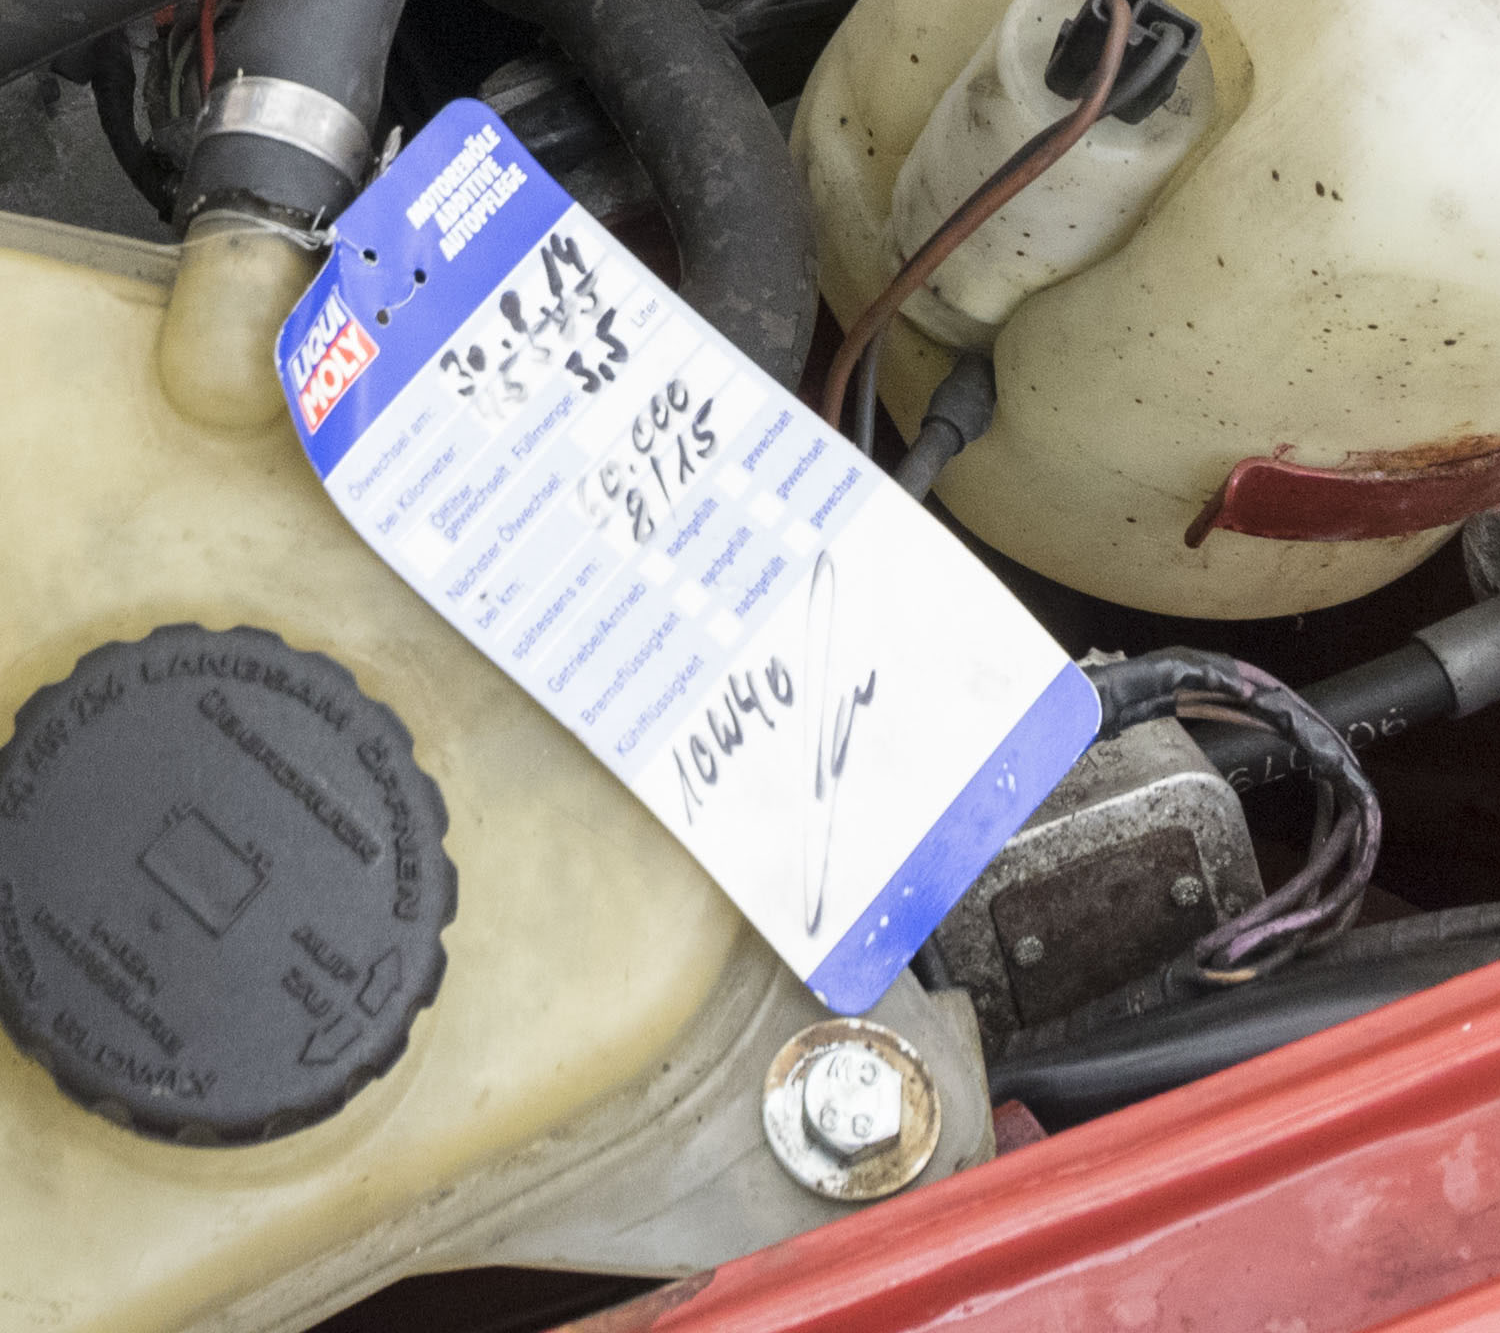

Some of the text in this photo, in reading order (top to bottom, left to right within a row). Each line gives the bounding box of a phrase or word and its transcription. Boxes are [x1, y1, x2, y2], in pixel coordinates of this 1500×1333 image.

[396, 118, 505, 232] MOTORENÖLE
[428, 154, 506, 234] ADDITIVE
[431, 160, 531, 264] AUTOPFLEGE
[291, 293, 350, 387] LIQUI
[628, 292, 664, 329] Liter
[304, 325, 380, 434] MOLY
[341, 402, 439, 503] Ölwechsel am:
[373, 437, 465, 536] bei Kilometer:
[426, 478, 477, 532] Ölfilter
[438, 386, 582, 542] gewechselt Füllmenge:
[442, 467, 570, 605] Nächster Ölwechsel:
[540, 406, 800, 697] Getriebe/Antrieb nachgefüllt gewechselt
[573, 434, 835, 728] Bremsflüssigkeit nachgefüllt gewechselt
[472, 574, 527, 631] bei km:
[508, 555, 605, 664] spätestens am:
[608, 651, 712, 760] Kühlflüssigkeit
[727, 552, 793, 621] nachgefüllt
[802, 461, 869, 531] gewechselt
